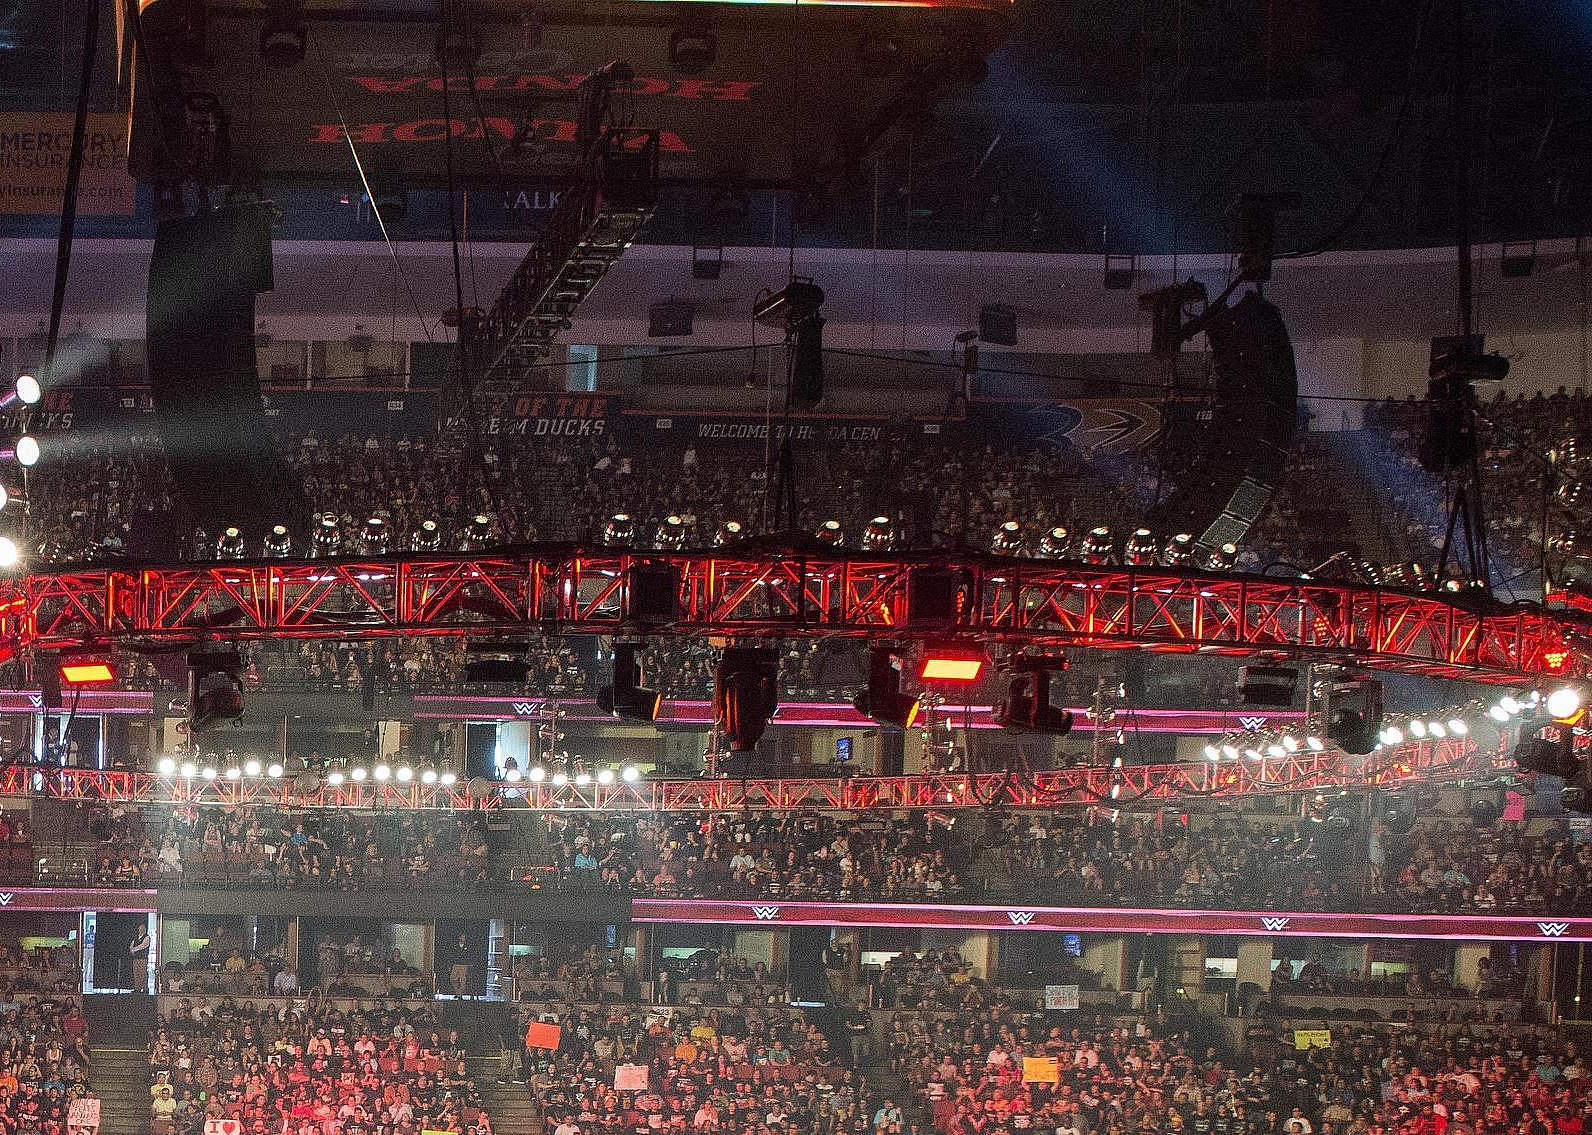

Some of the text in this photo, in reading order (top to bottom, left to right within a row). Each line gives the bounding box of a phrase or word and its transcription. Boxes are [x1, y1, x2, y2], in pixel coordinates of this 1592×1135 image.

[558, 397, 608, 417] THE
[534, 418, 606, 436] DUCKS
[698, 423, 768, 439] WELCOME
[209, 1120, 220, 1133] I
